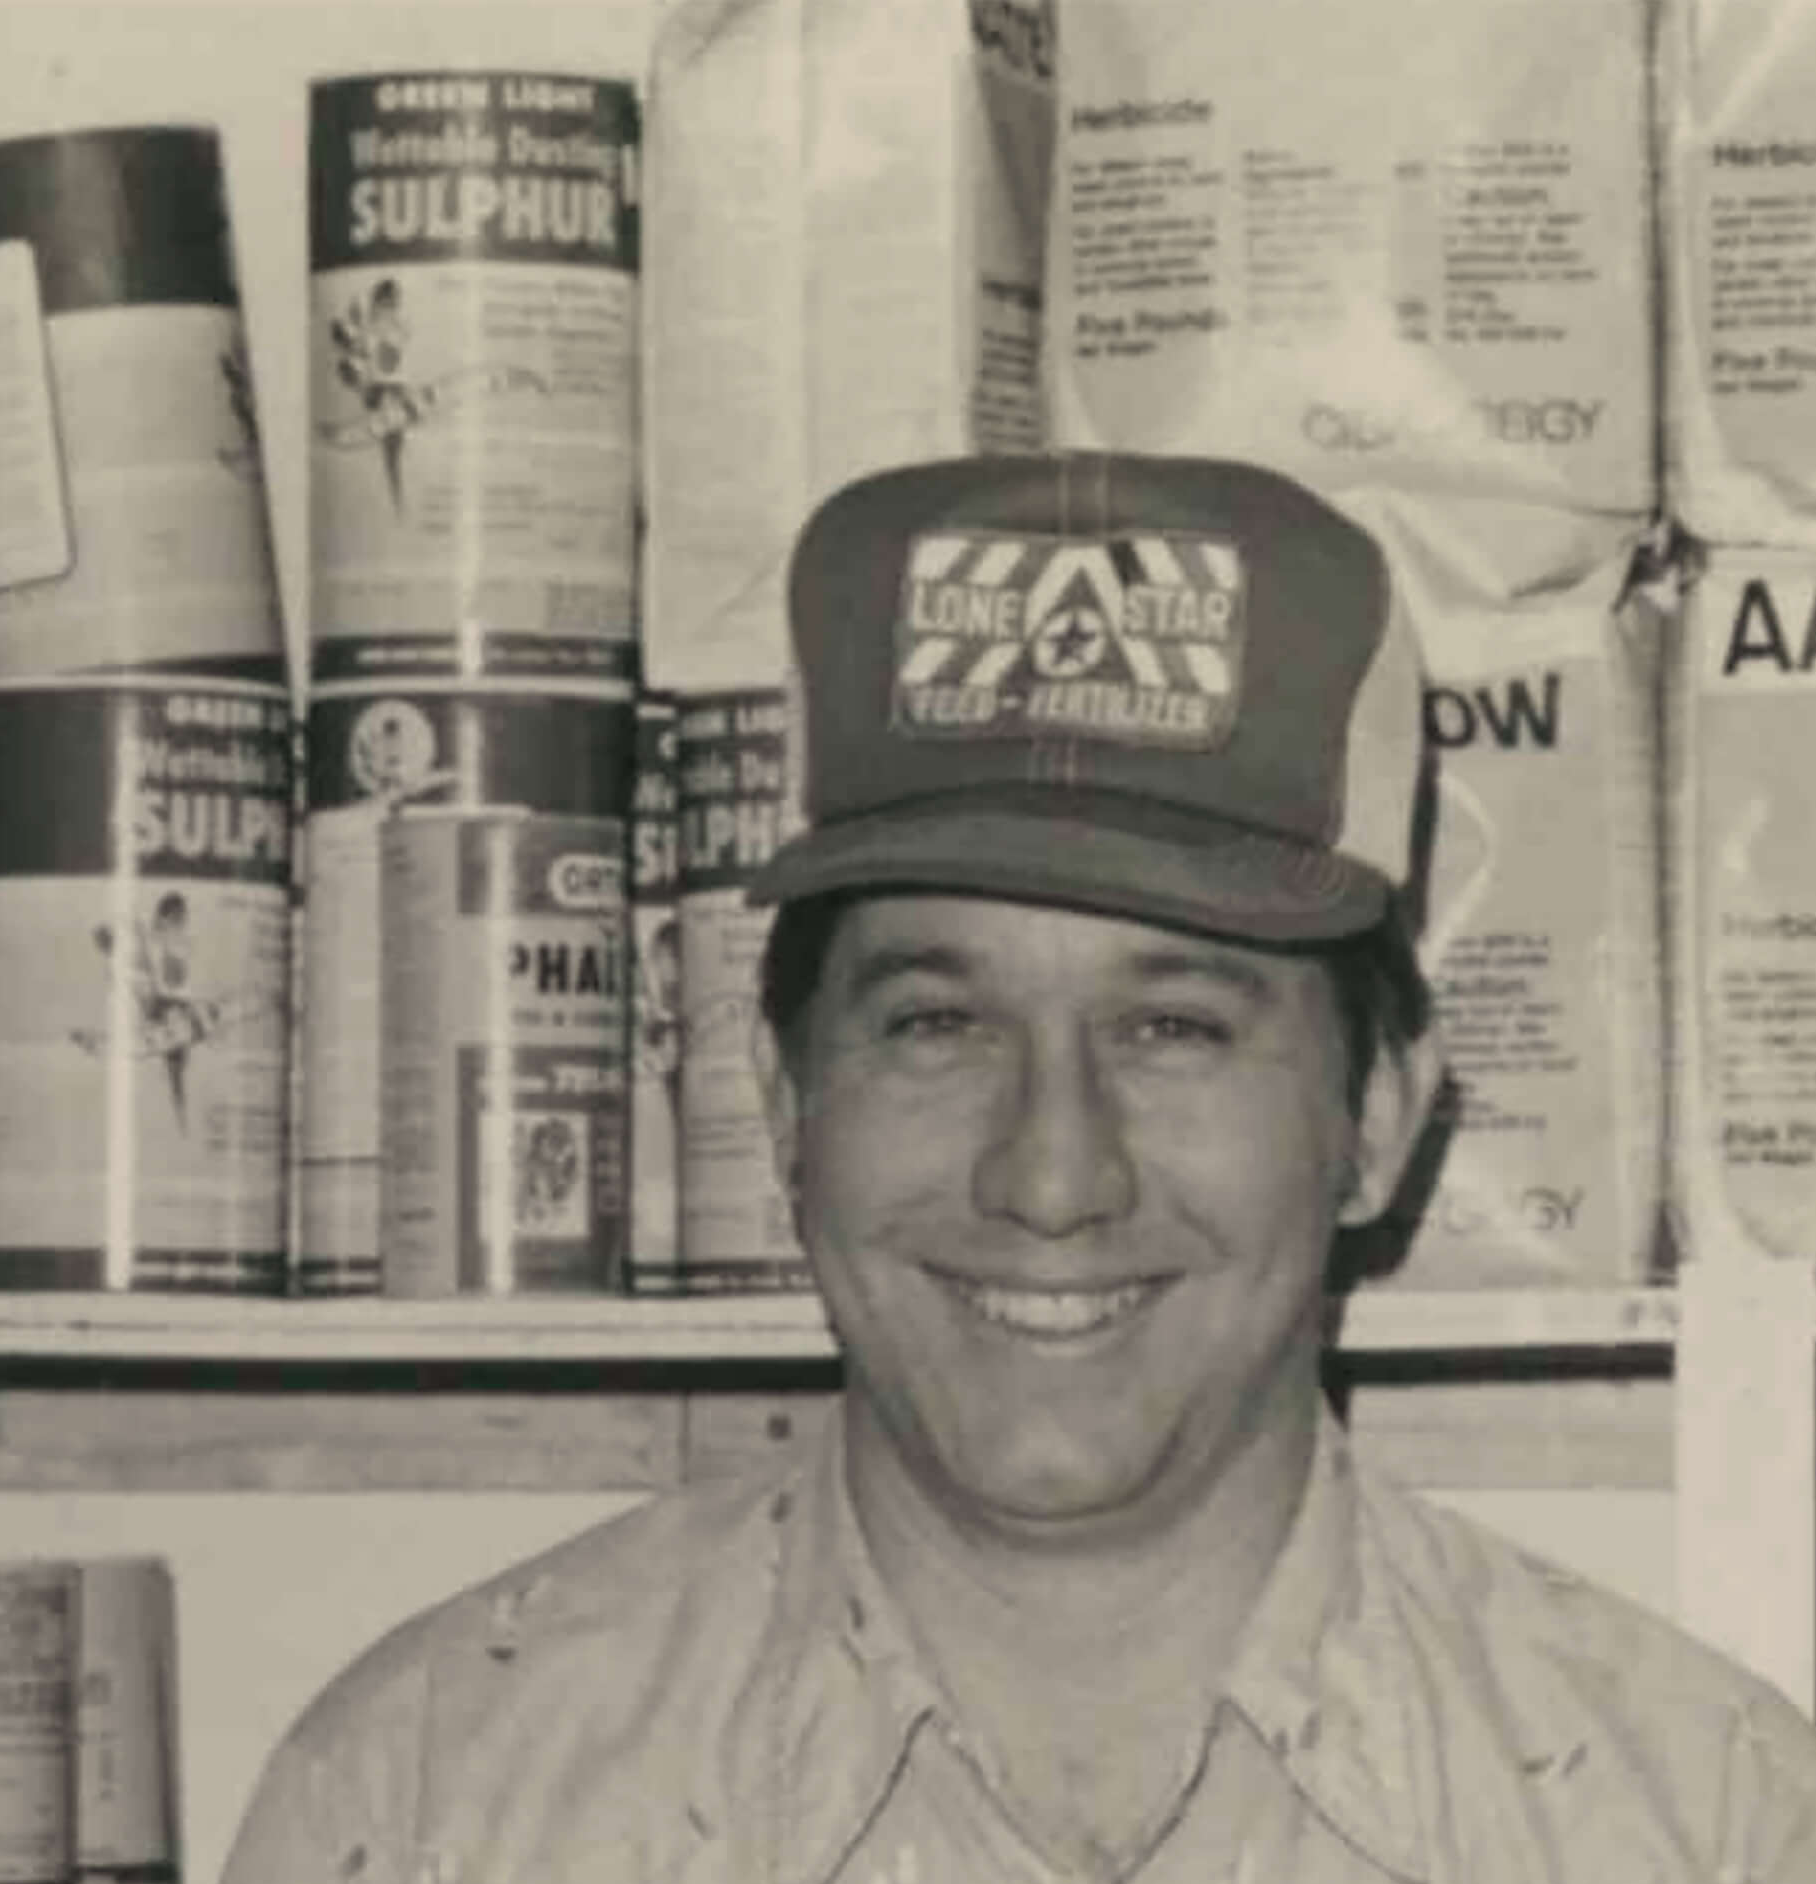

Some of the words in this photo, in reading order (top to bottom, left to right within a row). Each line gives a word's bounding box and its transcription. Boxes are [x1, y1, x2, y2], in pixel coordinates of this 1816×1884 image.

[349, 176, 616, 247] SULPHUR
[913, 582, 1026, 640] LONE
[1119, 586, 1231, 640] STAR
